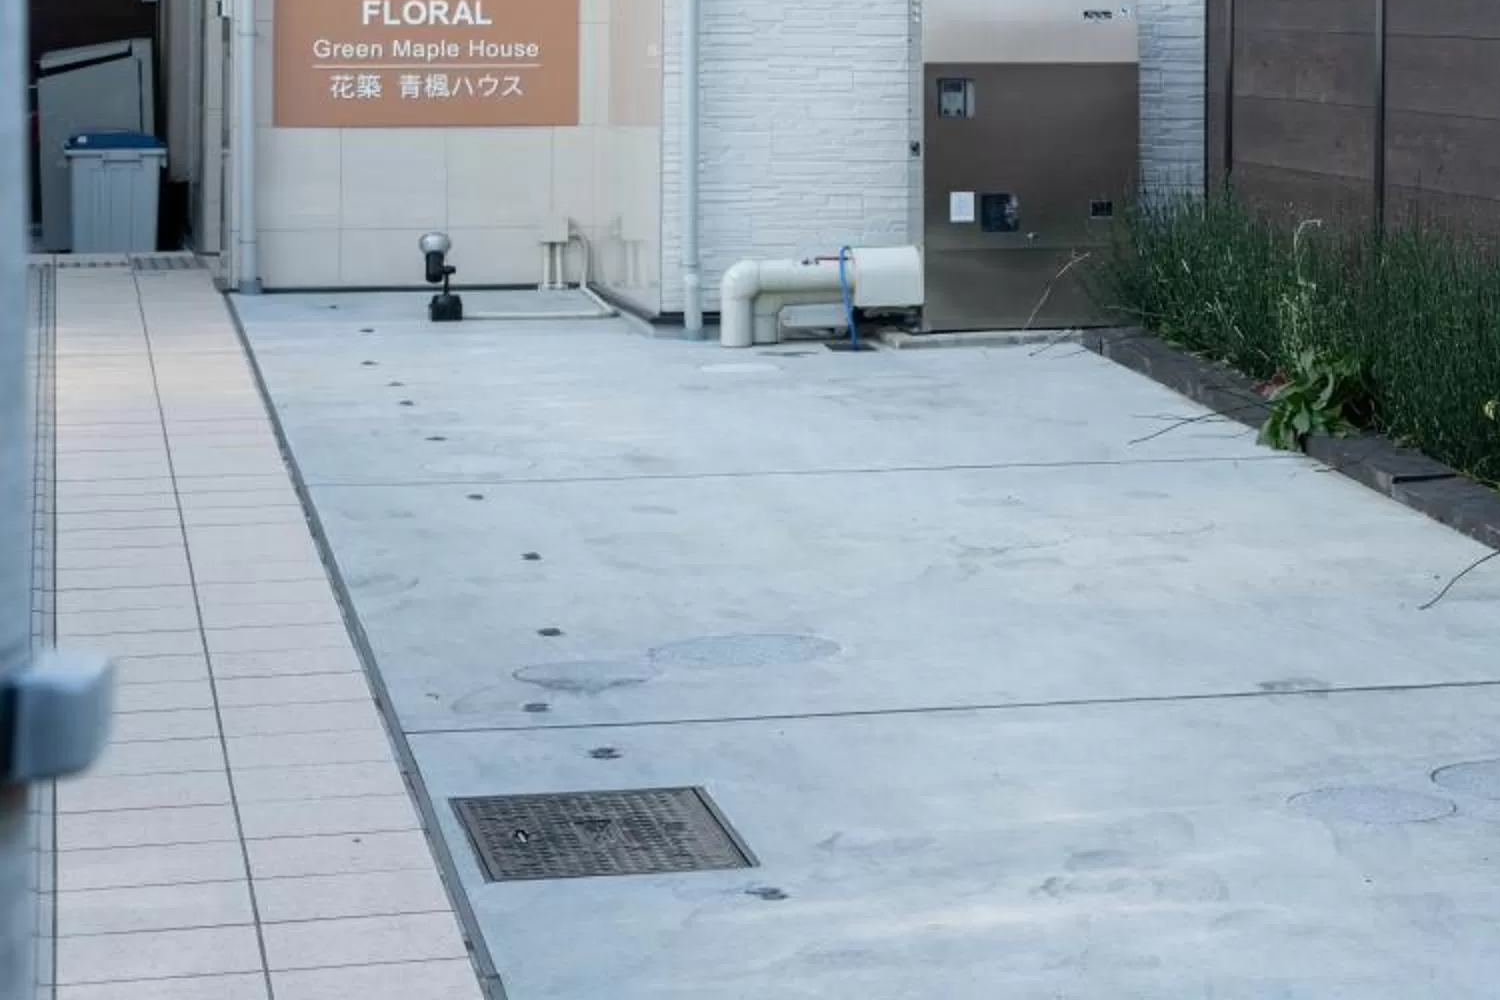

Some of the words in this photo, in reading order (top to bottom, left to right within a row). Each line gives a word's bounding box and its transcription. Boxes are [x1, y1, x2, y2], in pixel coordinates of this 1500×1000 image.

[361, 0, 493, 25] FLORAL
[312, 39, 384, 59] Green
[391, 39, 460, 62] Maple
[468, 39, 540, 58] House
[398, 73, 524, 99] 青楓ハウス
